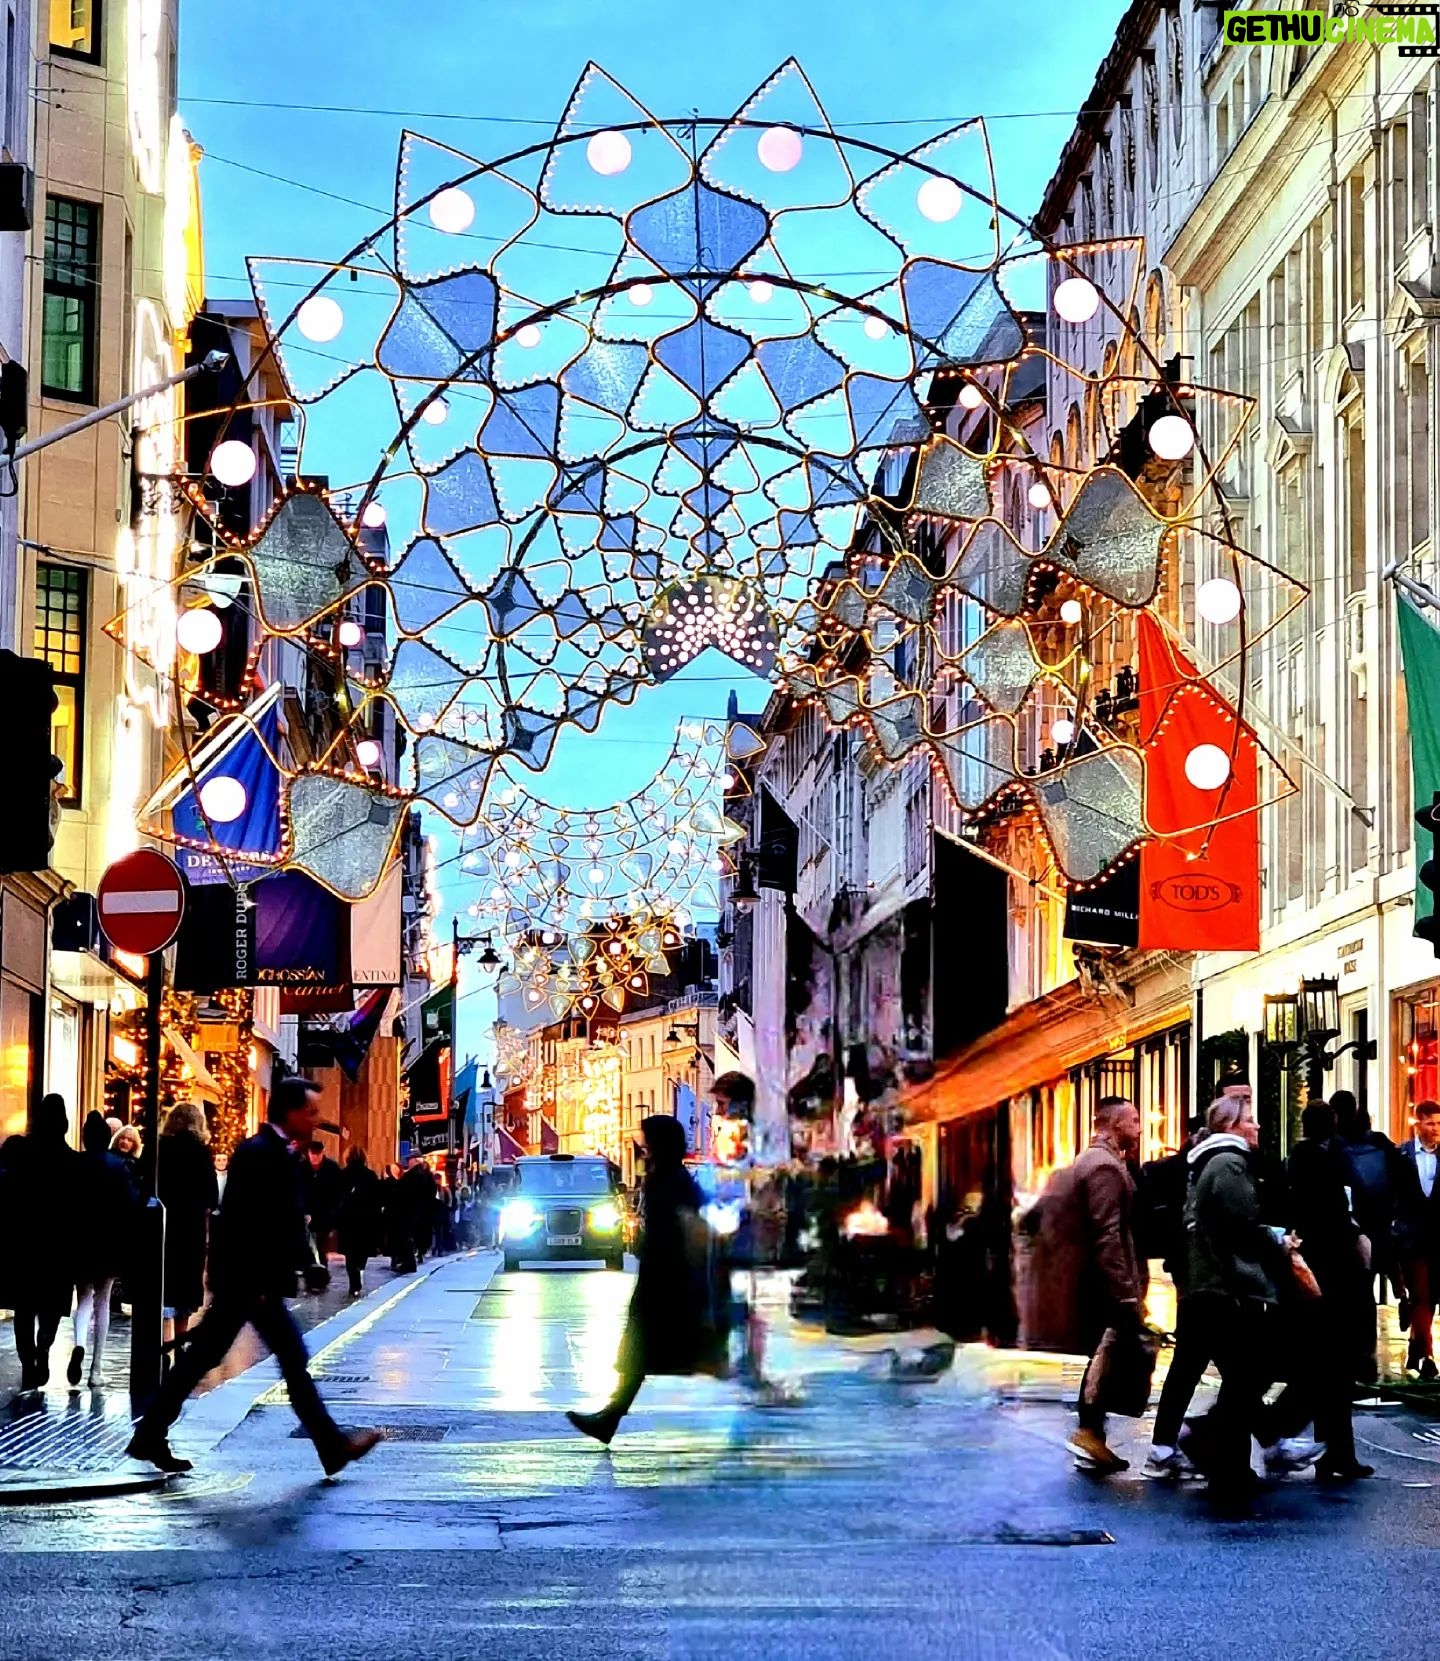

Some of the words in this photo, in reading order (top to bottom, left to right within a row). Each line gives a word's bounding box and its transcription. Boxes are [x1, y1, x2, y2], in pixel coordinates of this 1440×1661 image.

[1171, 884, 1220, 901] TOD'S
[1071, 904, 1111, 916] RICHARD
[236, 928, 248, 980] ROGER
